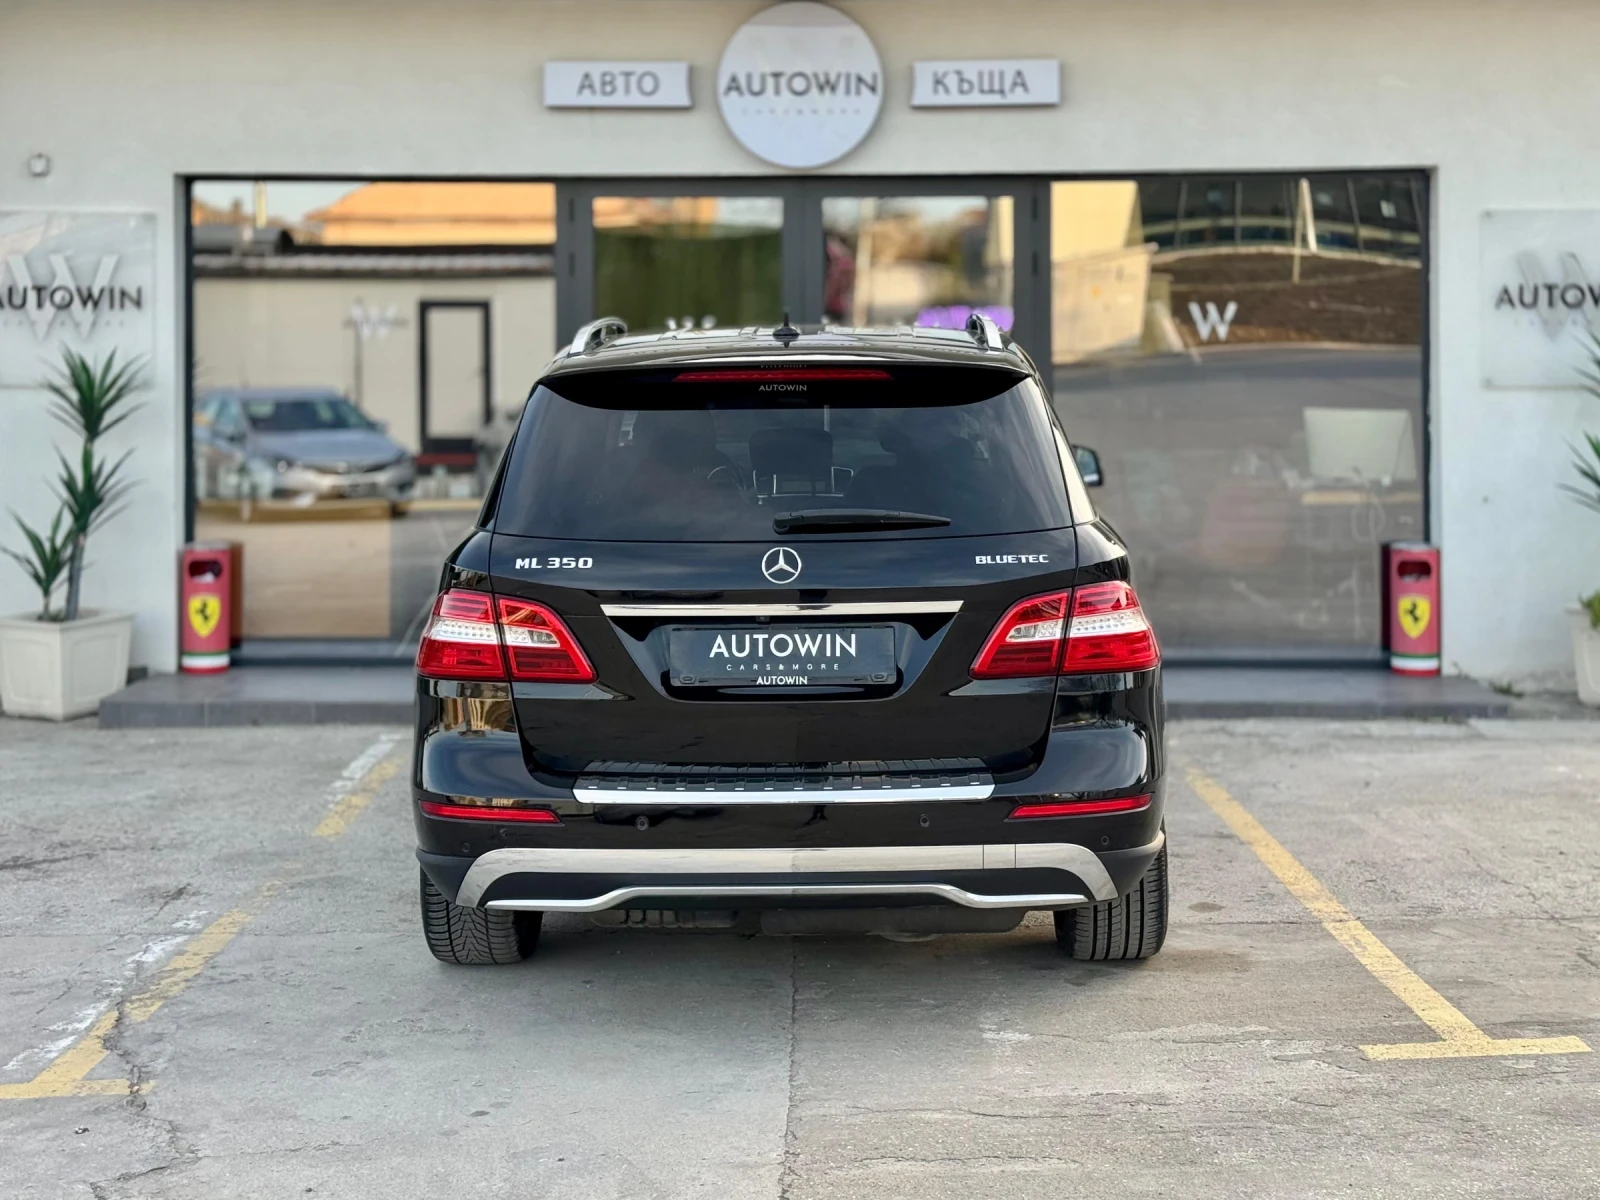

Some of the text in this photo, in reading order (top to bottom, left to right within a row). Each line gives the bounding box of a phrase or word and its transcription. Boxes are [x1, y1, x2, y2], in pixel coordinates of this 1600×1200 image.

[576, 70, 661, 97] АВТО
[723, 71, 878, 97] AUTOWIN
[931, 68, 1031, 99] КЪЩА
[0, 284, 143, 312] UTOWIN
[1187, 301, 1239, 343] W
[758, 384, 808, 392] AUTOWIN
[515, 557, 593, 569] ML 350
[975, 554, 1049, 565] BLUETEC
[709, 633, 856, 658] AUTOWIN
[756, 675, 808, 685] AUTOWIN
